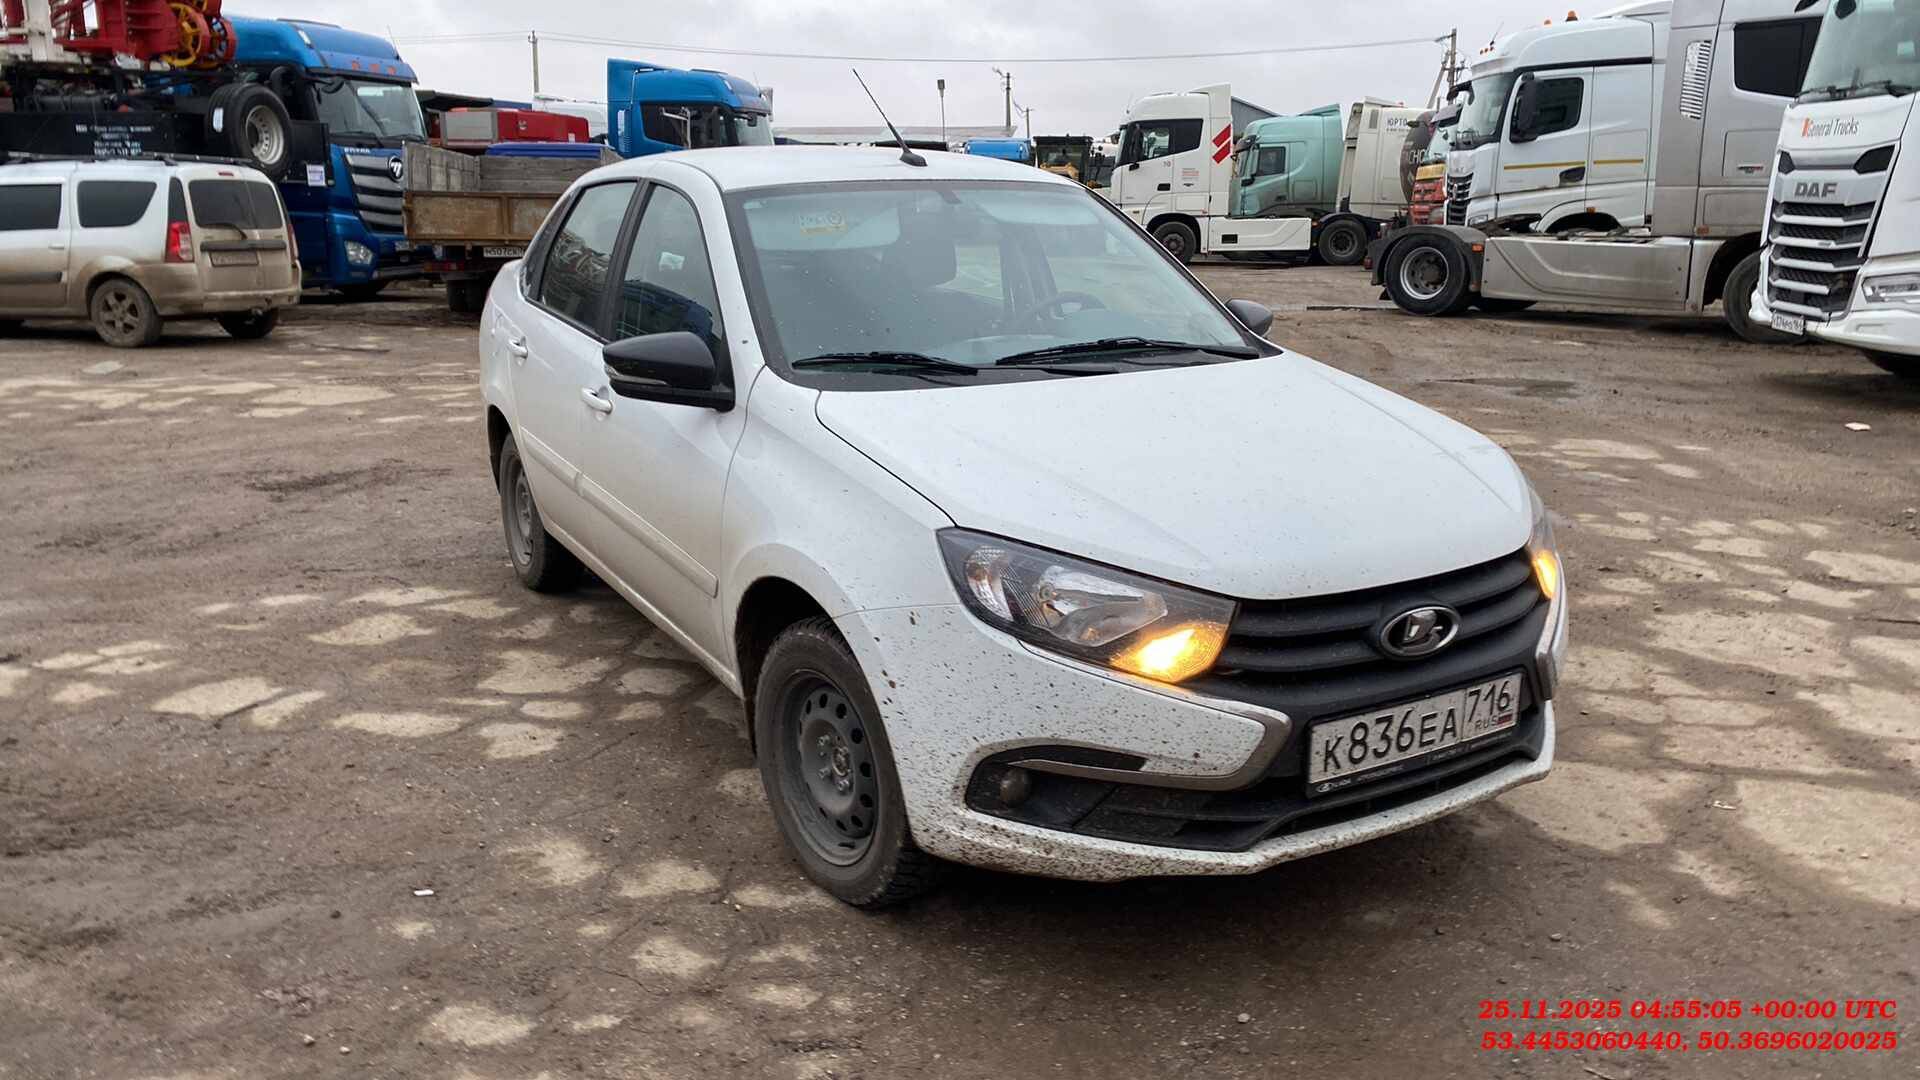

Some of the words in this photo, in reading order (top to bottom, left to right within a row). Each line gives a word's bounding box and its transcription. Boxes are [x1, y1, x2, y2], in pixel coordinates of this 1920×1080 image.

[1833, 116, 1859, 136] Trucks
[1794, 182, 1838, 198] DAF
[1323, 707, 1458, 772] К836ЕА
[1468, 680, 1512, 723] 716
[1475, 714, 1498, 730] RUS
